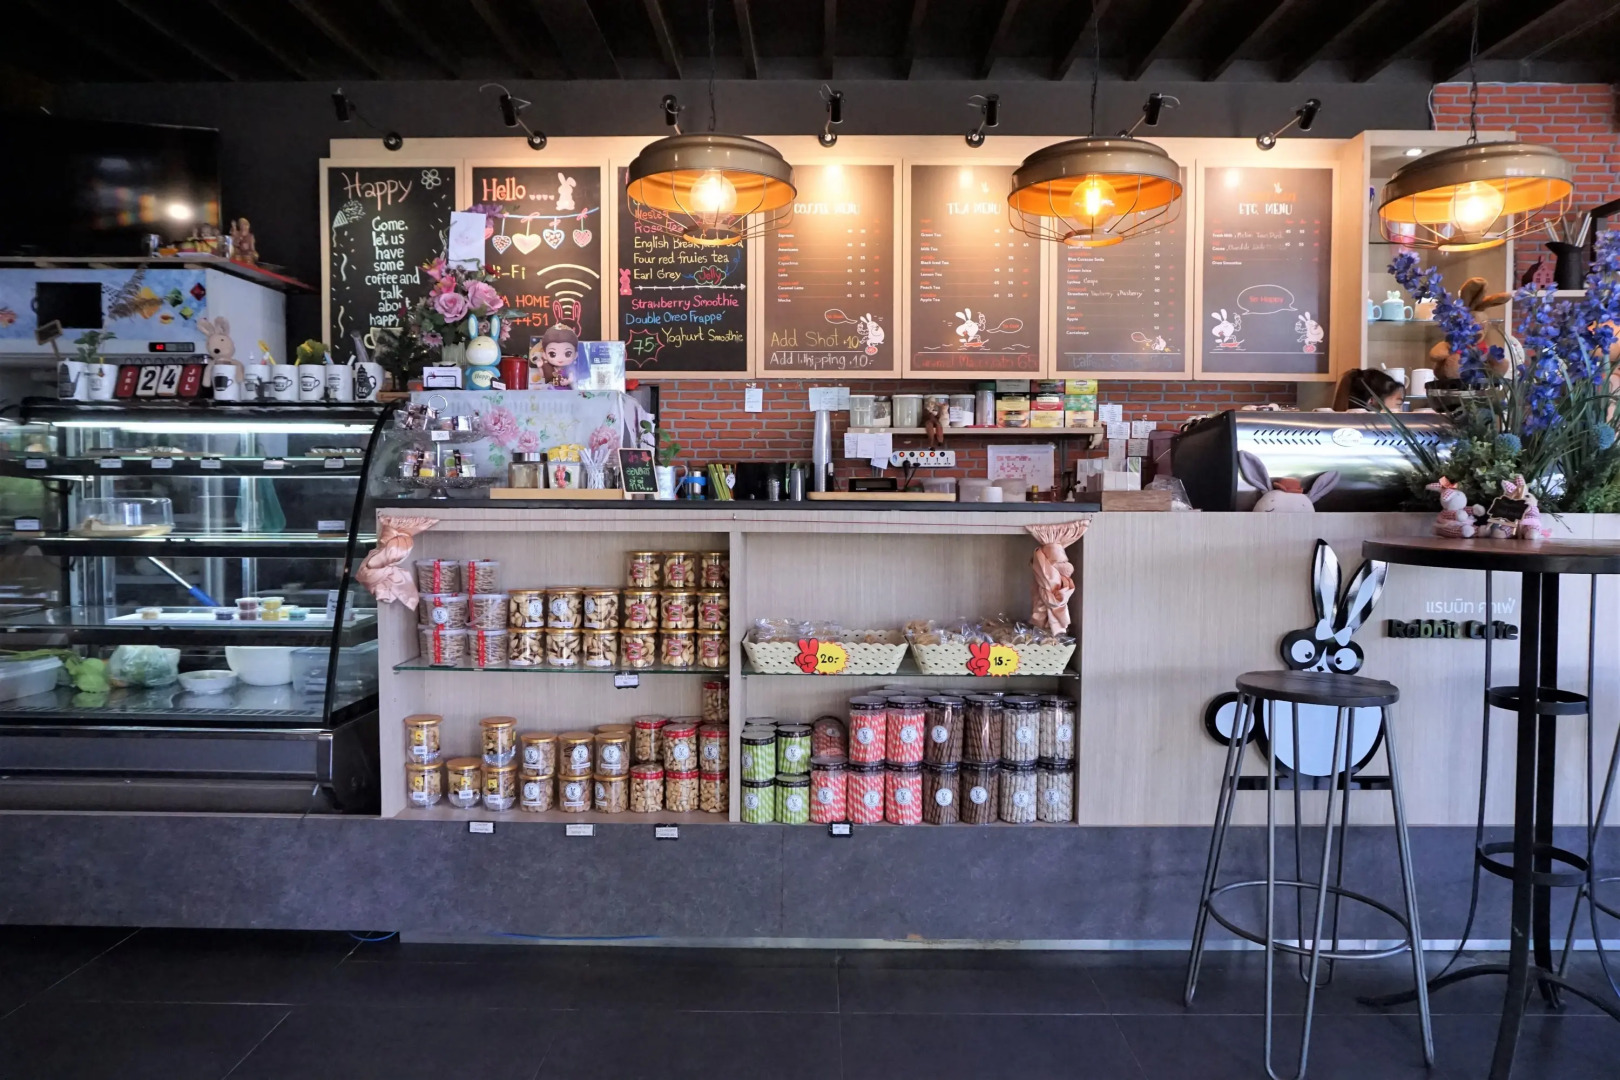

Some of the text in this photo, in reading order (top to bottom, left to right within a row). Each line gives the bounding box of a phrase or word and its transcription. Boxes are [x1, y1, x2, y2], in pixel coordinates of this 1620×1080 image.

[341, 171, 412, 211] Happy
[482, 178, 526, 201] Hello
[1265, 202, 1293, 215] MENU
[372, 231, 405, 246] let us
[634, 235, 669, 253] English
[375, 246, 404, 260] have
[634, 253, 655, 264] Four
[658, 253, 675, 264] red
[711, 250, 730, 263] tea
[373, 259, 404, 272] some
[365, 266, 421, 286] coffee and
[633, 268, 722, 284] Earl Grey Jelly
[378, 284, 404, 300] talk
[516, 294, 550, 308] HOME
[631, 293, 739, 310] Strawberry Smoothie
[625, 311, 661, 325] Double
[663, 312, 687, 322] Oreo
[661, 326, 744, 348] Yoghurt Smoothie
[771, 329, 798, 347] Add
[805, 328, 839, 347] Shot
[770, 352, 793, 365] Add
[1387, 619, 1462, 639] Rabbit
